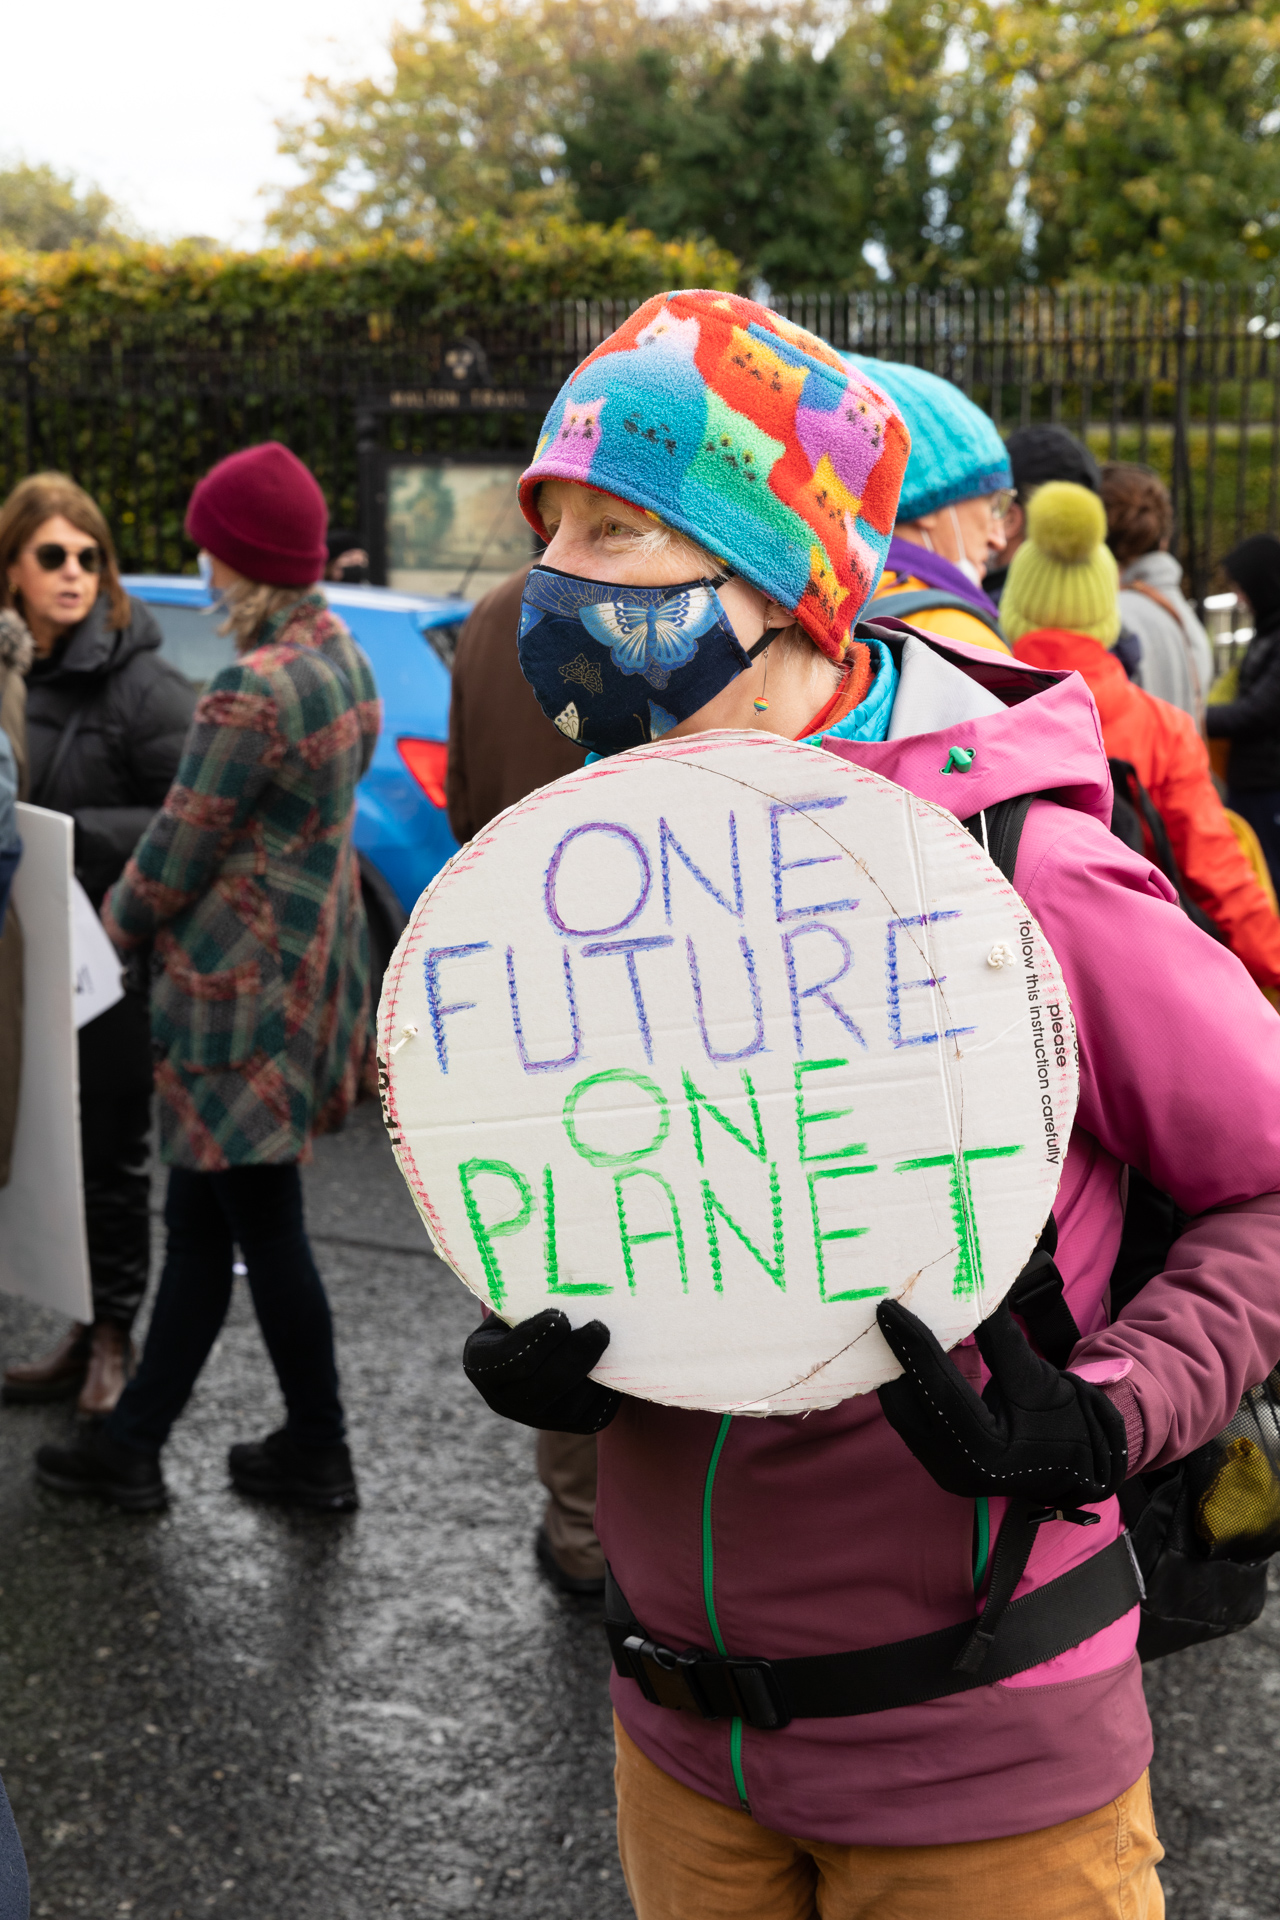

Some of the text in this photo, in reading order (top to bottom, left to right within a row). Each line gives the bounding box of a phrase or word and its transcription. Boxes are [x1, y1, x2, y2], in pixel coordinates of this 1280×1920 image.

[542, 796, 860, 938] ONE
[421, 910, 979, 1076] FUTURE
[1018, 919, 1060, 1165] follow this instruction carefully
[1047, 1003, 1067, 1068] please
[562, 1058, 870, 1168] ONE
[458, 1144, 1027, 1309] PLANET
